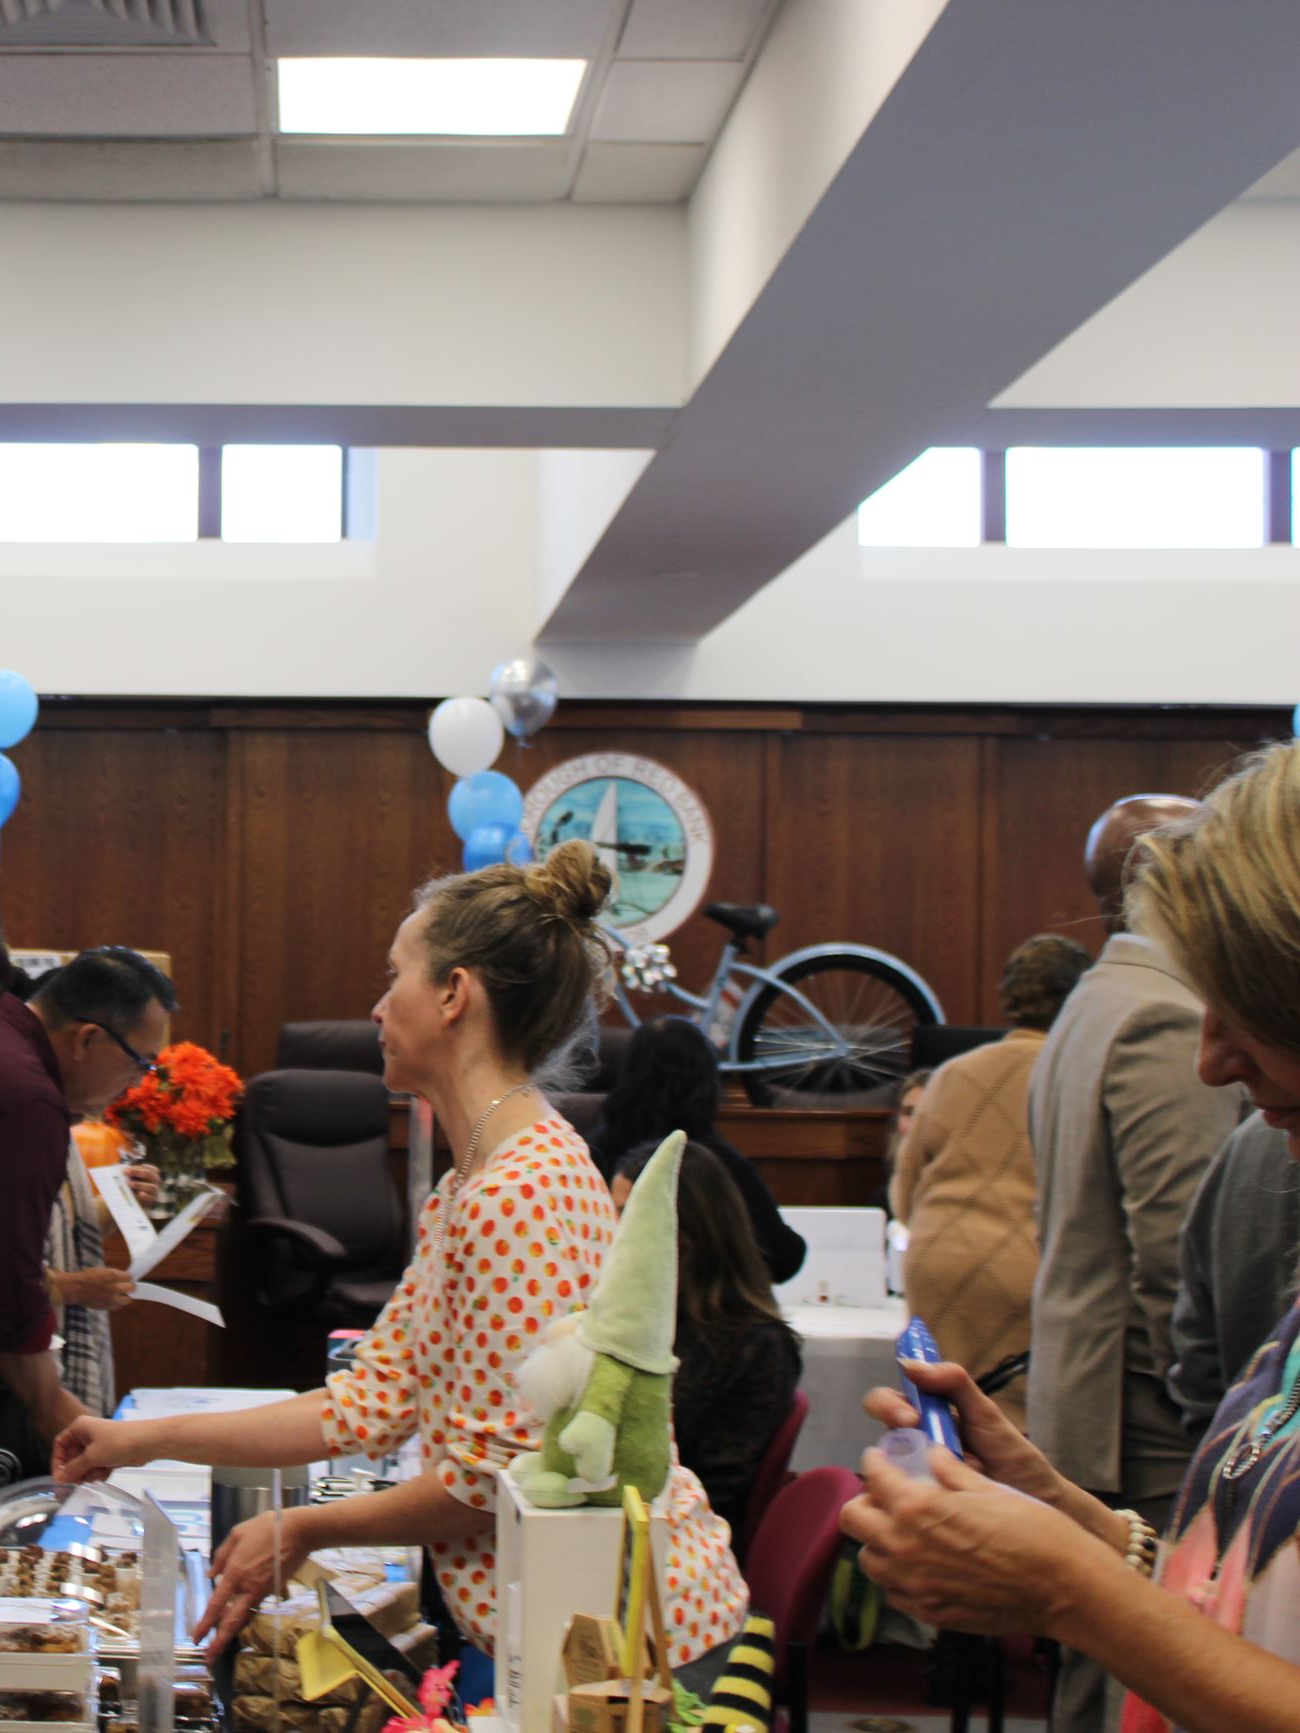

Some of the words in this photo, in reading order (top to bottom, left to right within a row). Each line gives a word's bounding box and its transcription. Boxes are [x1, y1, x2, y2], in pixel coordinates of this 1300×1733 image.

[520, 758, 587, 834] OROUGH
[595, 756, 625, 774] OF
[631, 757, 676, 794] RED
[674, 792, 708, 846] BANK
